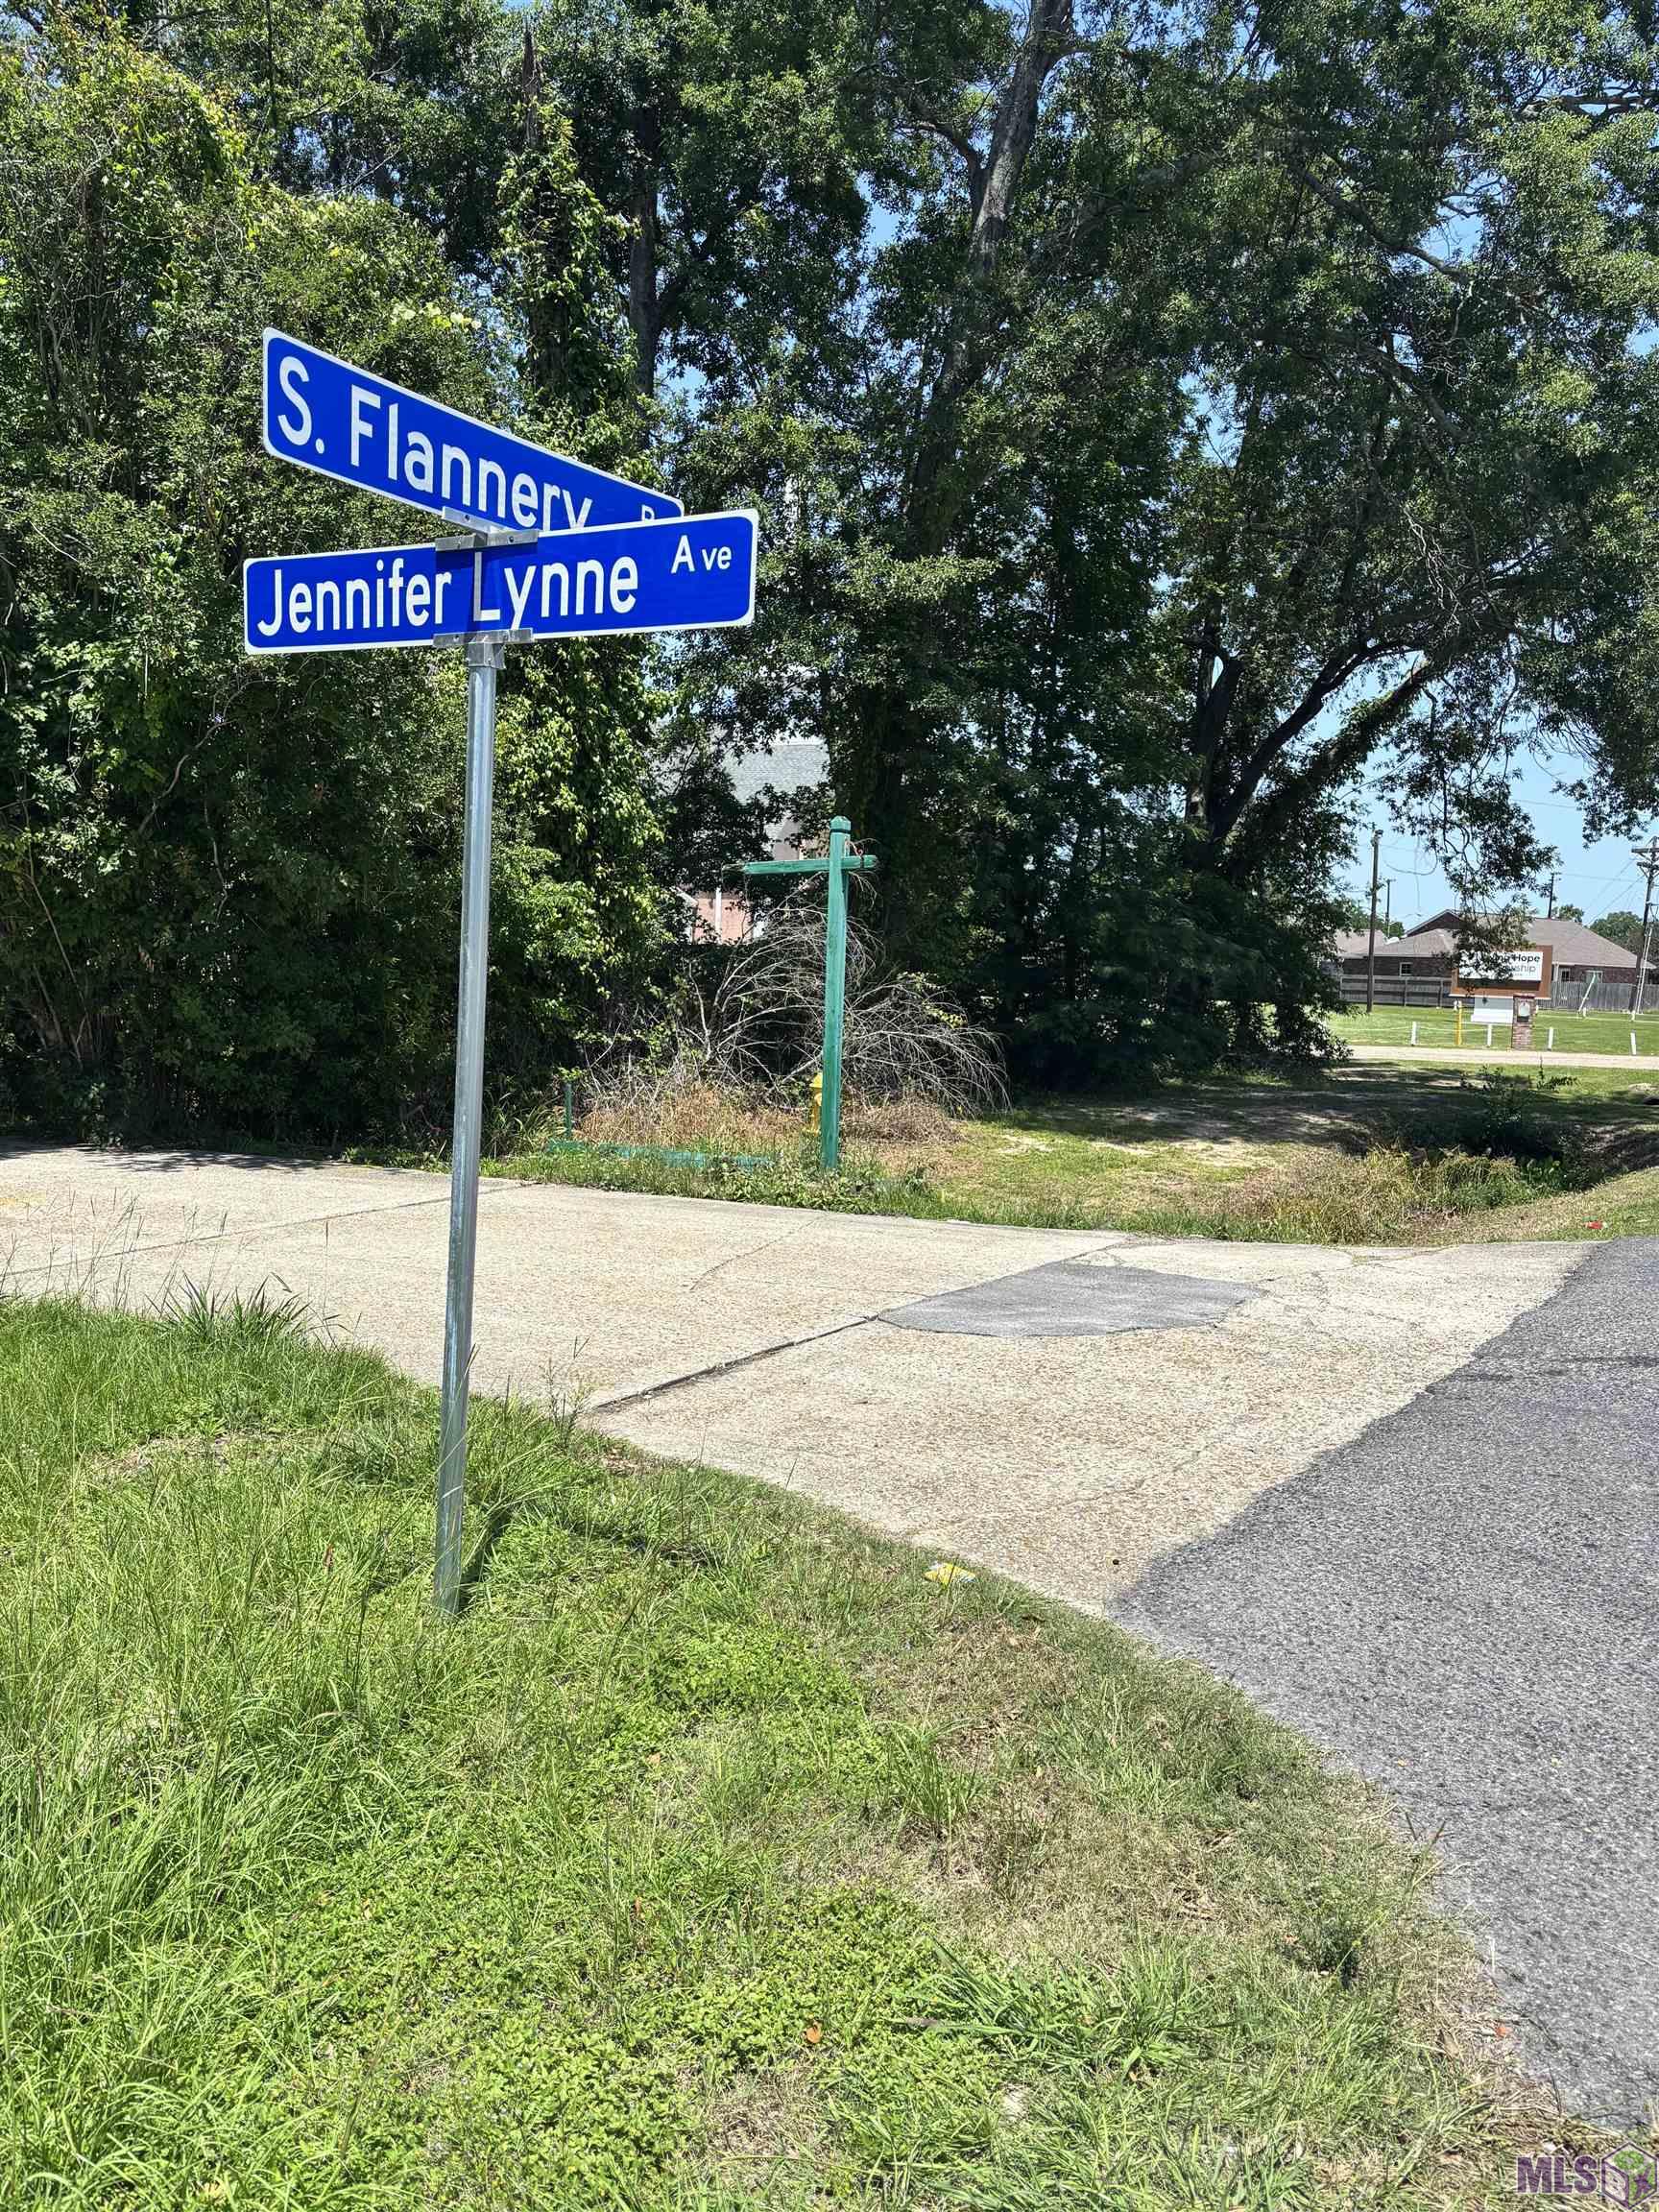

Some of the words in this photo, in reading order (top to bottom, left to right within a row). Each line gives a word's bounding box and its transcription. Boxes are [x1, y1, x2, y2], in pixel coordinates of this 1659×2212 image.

[277, 355, 325, 454] S.
[349, 385, 593, 530] Flannery
[256, 557, 453, 637] Jennifer
[473, 551, 638, 630] Lynne
